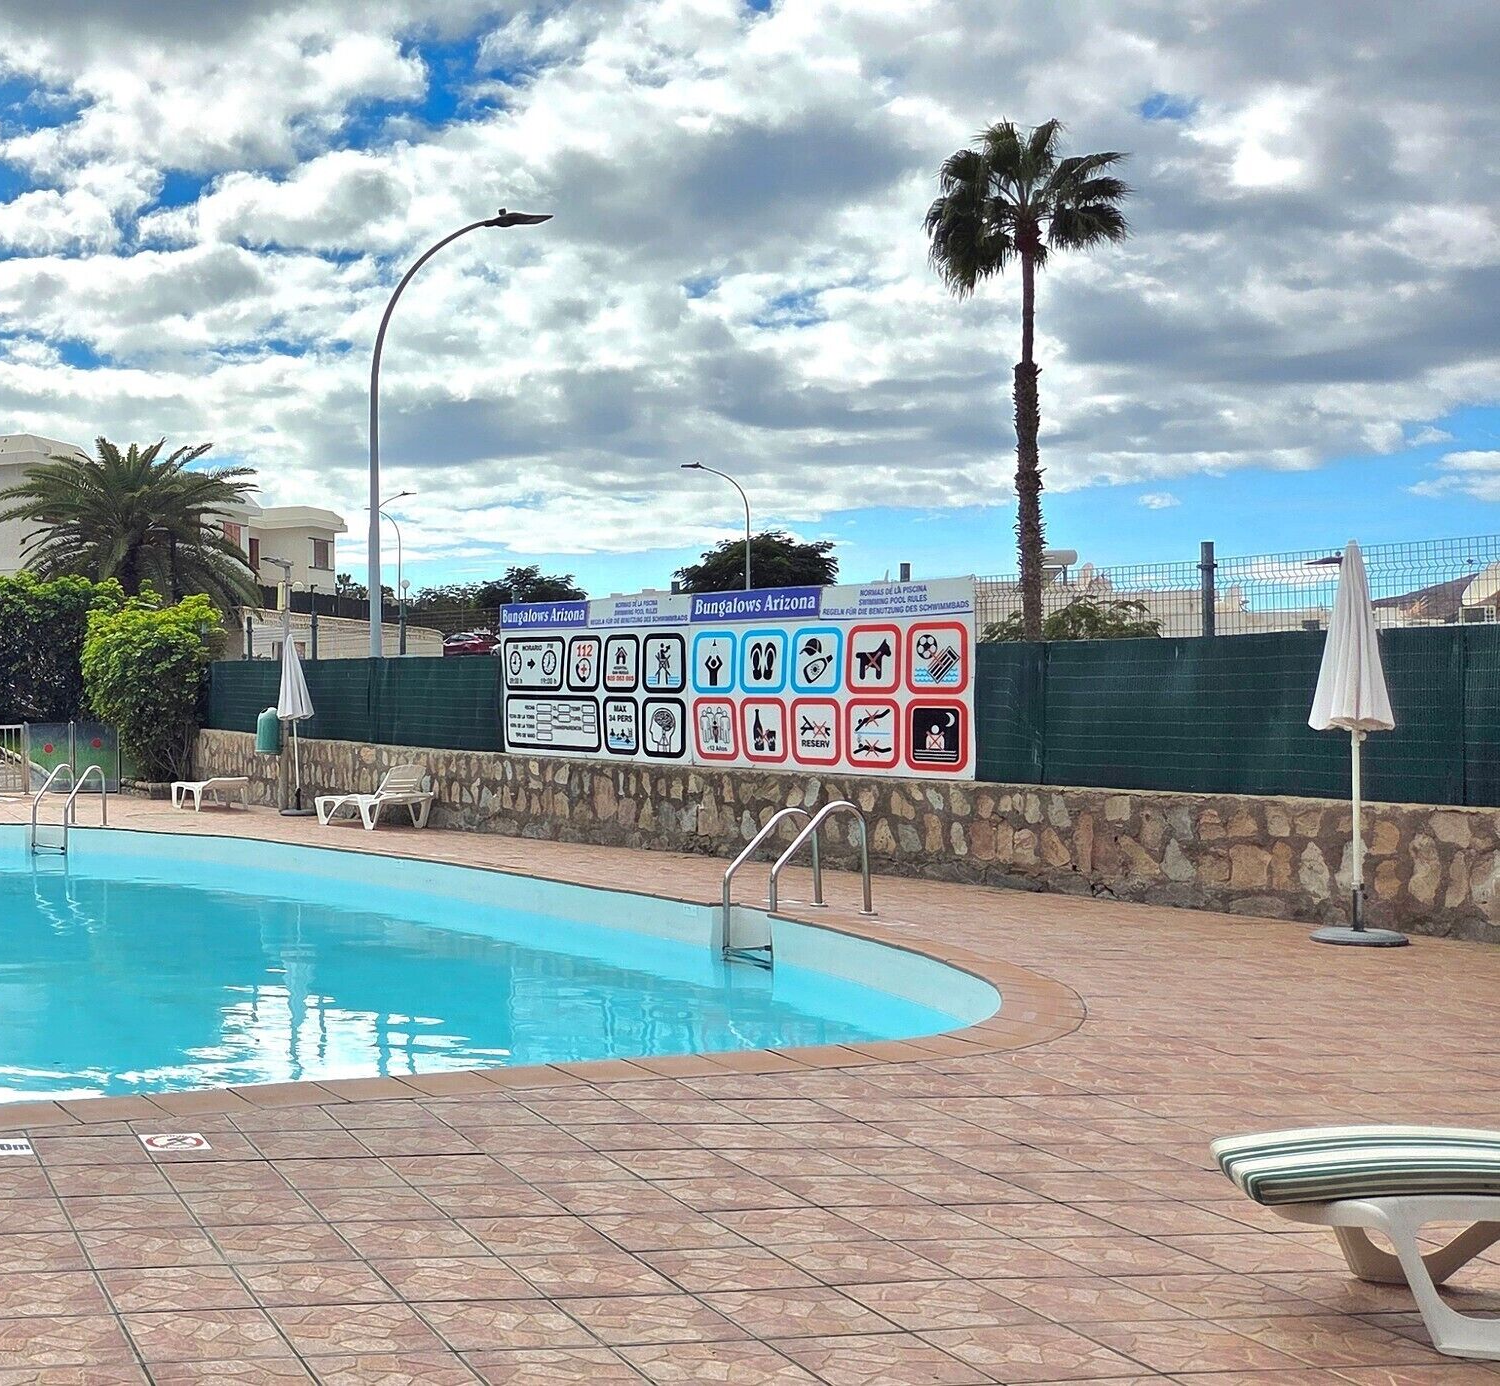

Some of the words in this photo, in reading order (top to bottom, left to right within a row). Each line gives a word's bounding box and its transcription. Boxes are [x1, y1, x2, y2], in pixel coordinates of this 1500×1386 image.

[859, 588, 884, 597] NORMAS
[885, 587, 893, 595] DE
[903, 584, 927, 594] PISCINA
[694, 597, 761, 618] Bungalows
[763, 594, 816, 612] Arizona
[889, 596, 906, 605] POOL
[907, 594, 928, 603] RULES
[857, 607, 868, 615] DIE
[905, 604, 918, 613] DES
[919, 600, 970, 611] SCHWIMMBADS
[502, 608, 548, 626] Bungalows
[549, 607, 585, 622] Arizona
[576, 644, 593, 657] 112
[613, 705, 627, 713] MAX
[617, 714, 633, 723] PERS
[801, 739, 830, 749] RESERV
